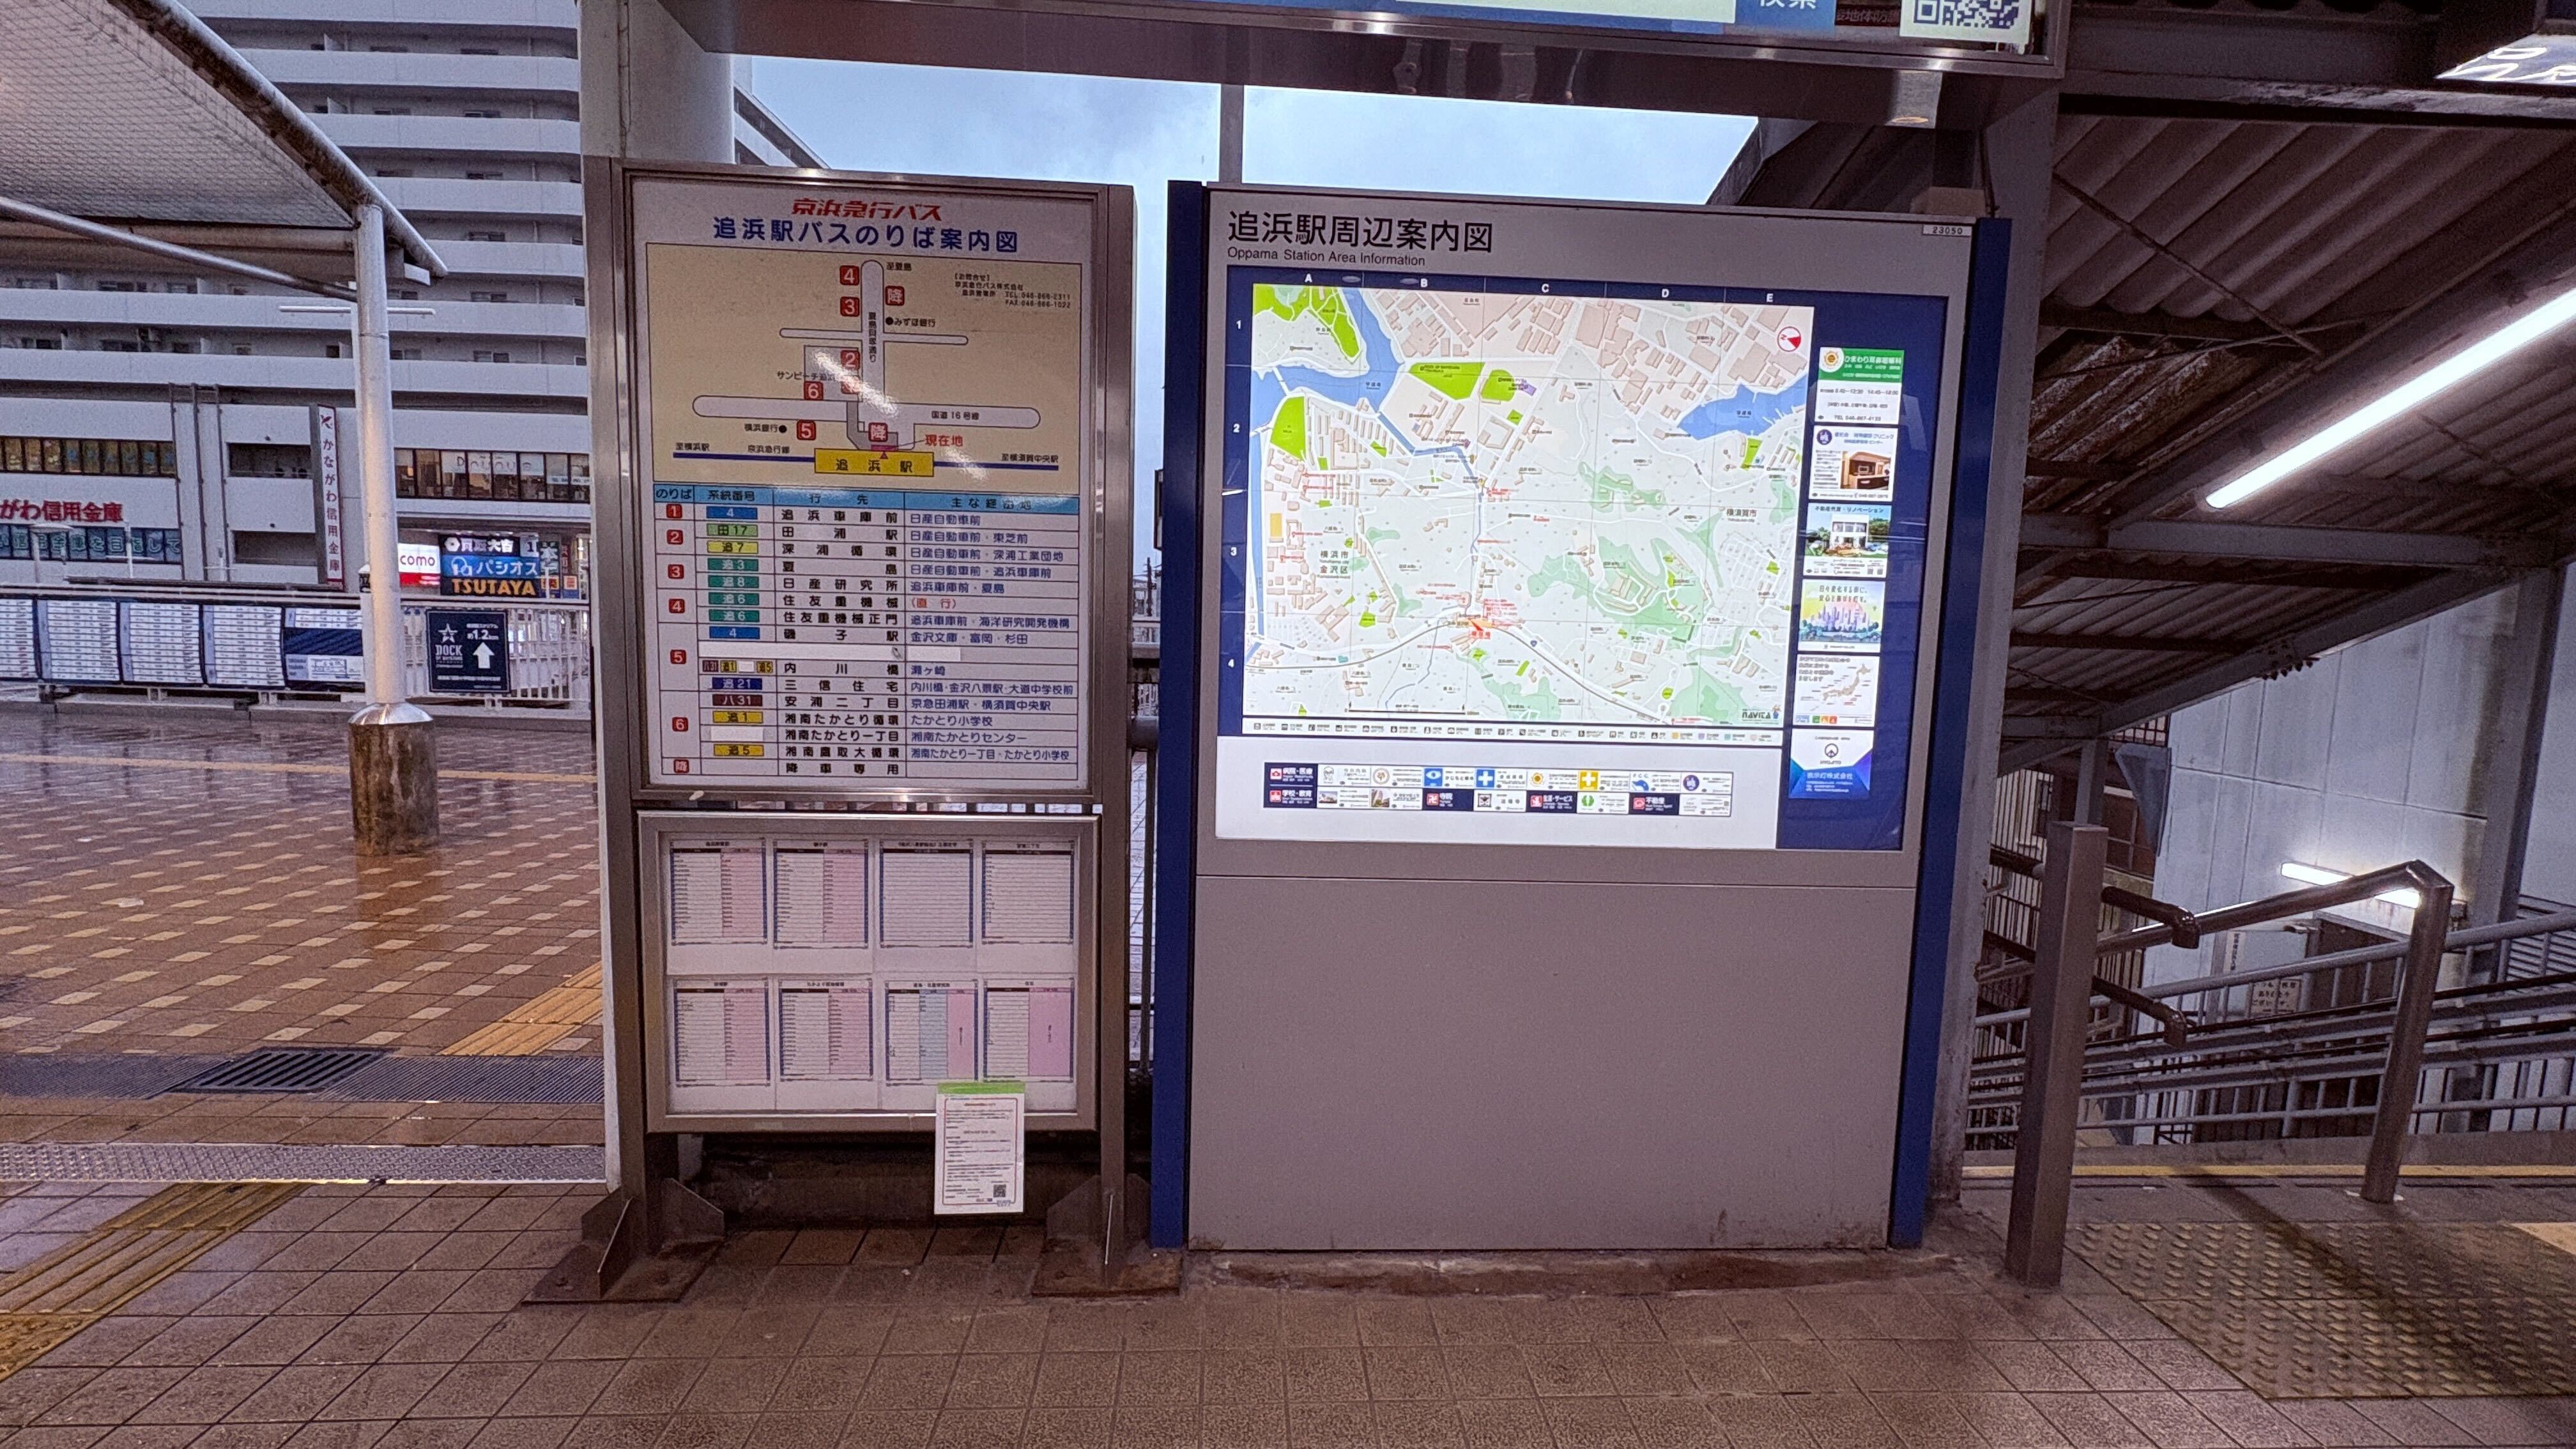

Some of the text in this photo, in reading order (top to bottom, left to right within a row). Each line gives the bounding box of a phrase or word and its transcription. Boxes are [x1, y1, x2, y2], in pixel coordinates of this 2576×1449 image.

[792, 197, 942, 222] 京浜急行バス
[713, 217, 1018, 253] 追浜駅バスのりば案内図
[1227, 210, 1493, 253] 追浜駅周辺案内図
[1932, 226, 1963, 235] 23050
[1227, 247, 1425, 266] Oppama Station Area Information
[843, 268, 855, 284] 4
[1305, 273, 1313, 283] A
[1420, 278, 1428, 288] B
[1541, 284, 1549, 293] C
[889, 289, 903, 304] 降
[1661, 289, 1669, 298] D
[1766, 293, 1774, 302] E
[843, 299, 855, 314] 3
[1236, 320, 1241, 330] 1
[845, 352, 856, 367] 2
[808, 383, 819, 399] 6
[801, 423, 812, 439] 5
[870, 424, 886, 440] 降
[1233, 424, 1240, 433] 2
[924, 434, 963, 447] 現在地
[836, 458, 913, 473] 追浜駅
[656, 488, 693, 500] のりば
[708, 490, 756, 502] 系統番号
[0, 498, 123, 523] がわ信用金庫
[323, 438, 340, 572] かながわ信用金庫
[670, 507, 678, 517] 1
[726, 508, 734, 518] 4
[781, 509, 898, 524] 追浜車庫前
[910, 513, 981, 526] 日産自動車前
[670, 531, 679, 543] 2
[782, 526, 898, 540] 田浦駅
[1230, 547, 1237, 556] 3
[400, 555, 436, 567] como
[476, 560, 539, 576] パシオス
[671, 566, 680, 578] 3
[451, 578, 537, 596] TSUTAYA
[783, 578, 898, 592] 日産研究所
[672, 601, 682, 613] 4
[729, 628, 737, 637] 4
[910, 631, 1028, 644] 金沢文庫・富岡・杉田
[435, 645, 463, 656] DOCK
[673, 651, 683, 663] 5
[784, 663, 899, 675] 内川橋
[785, 679, 899, 693] 三信住宅
[785, 696, 899, 709] 安浦二丁目
[675, 719, 685, 730] 6
[911, 715, 993, 727] たかとり小学校
[785, 729, 899, 742] 湘南たかとり一丁目
[911, 732, 1028, 744] 湘南たかとりセンター
